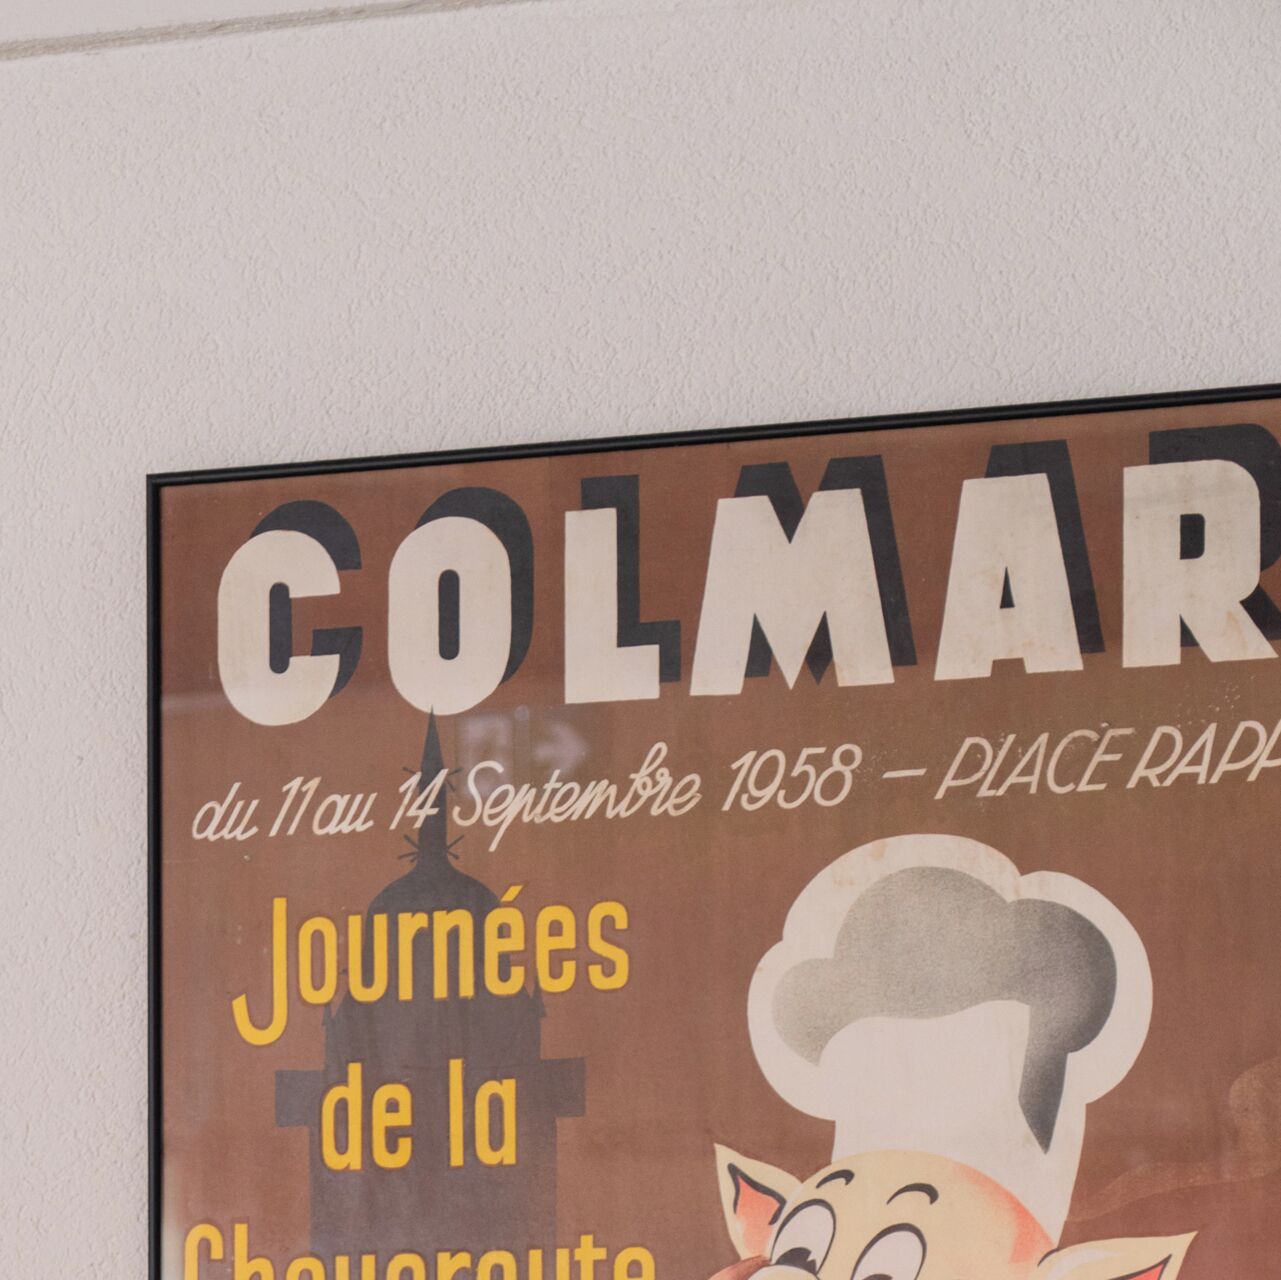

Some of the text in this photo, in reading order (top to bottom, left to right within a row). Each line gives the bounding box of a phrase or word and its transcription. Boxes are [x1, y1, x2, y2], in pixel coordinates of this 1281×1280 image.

[217, 458, 1279, 727] COLMAR
[191, 781, 259, 842] du
[269, 776, 322, 837] 11
[312, 791, 379, 836] au
[390, 767, 449, 830] 14
[452, 741, 703, 853] Septembre
[721, 742, 862, 813] 1958
[933, 727, 1136, 801] PLACE
[231, 884, 630, 1047] Journées
[321, 1058, 517, 1171] de la
